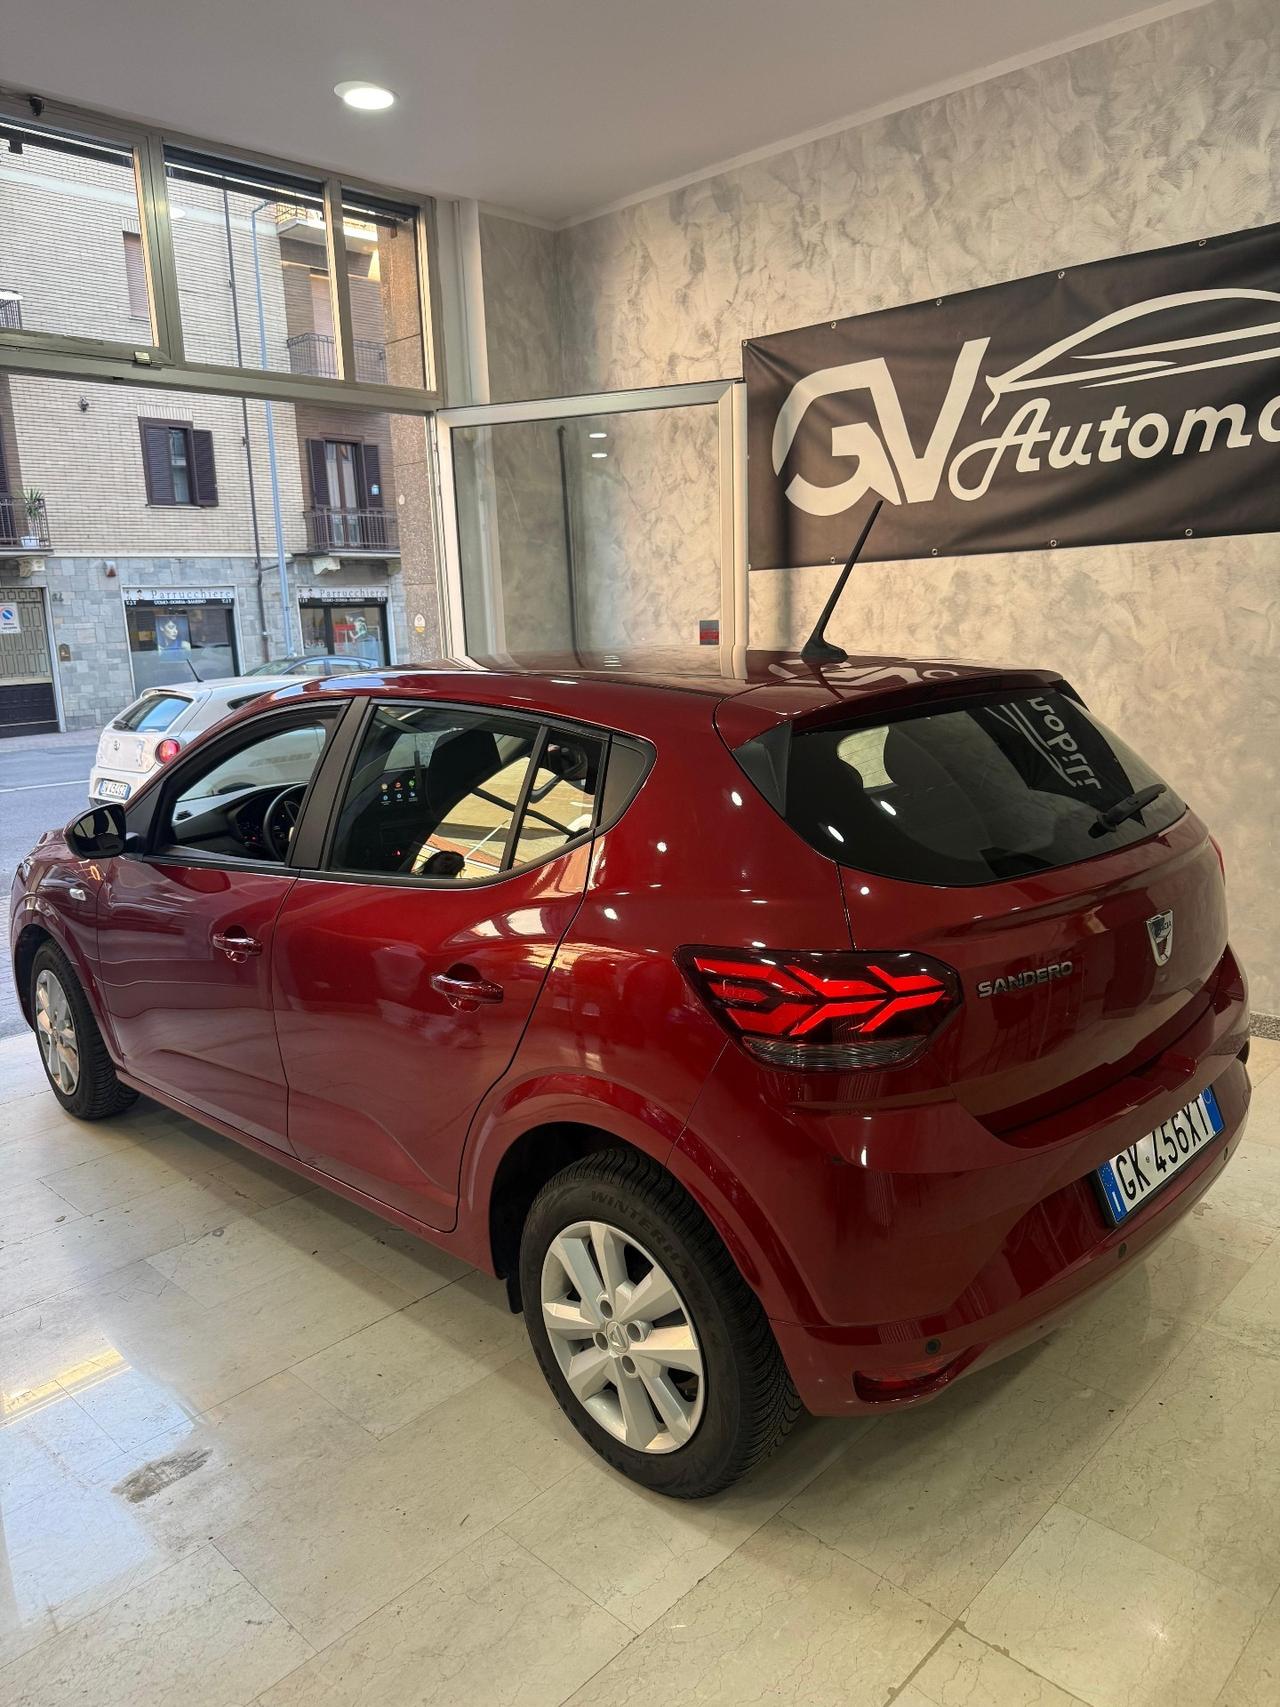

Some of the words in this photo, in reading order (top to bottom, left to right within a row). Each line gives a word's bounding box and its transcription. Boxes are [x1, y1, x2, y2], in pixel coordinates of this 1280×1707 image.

[772, 337, 991, 517] GV
[151, 588, 231, 600] Parrucchiere
[320, 588, 386, 598] Parrucchiere
[977, 960, 1074, 998] SANDERO
